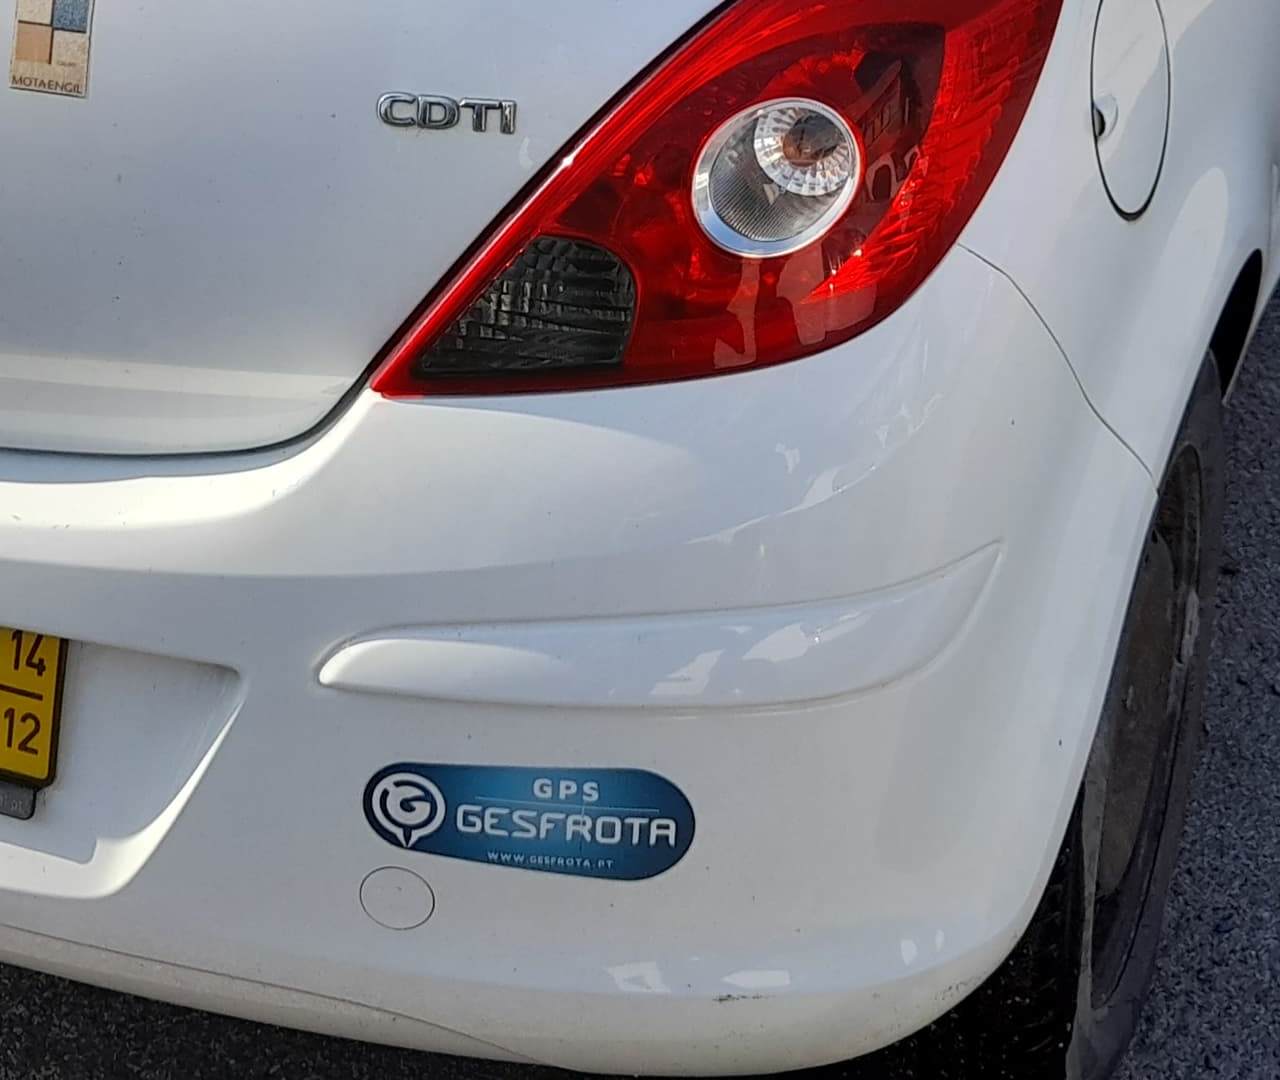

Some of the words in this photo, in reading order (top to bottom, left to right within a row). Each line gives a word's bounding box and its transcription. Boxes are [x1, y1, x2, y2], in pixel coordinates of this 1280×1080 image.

[377, 91, 518, 135] CDTI
[11, 629, 47, 677] 14
[4, 707, 41, 756] 12
[532, 778, 600, 802] GPS
[456, 804, 677, 848] GESFROTA
